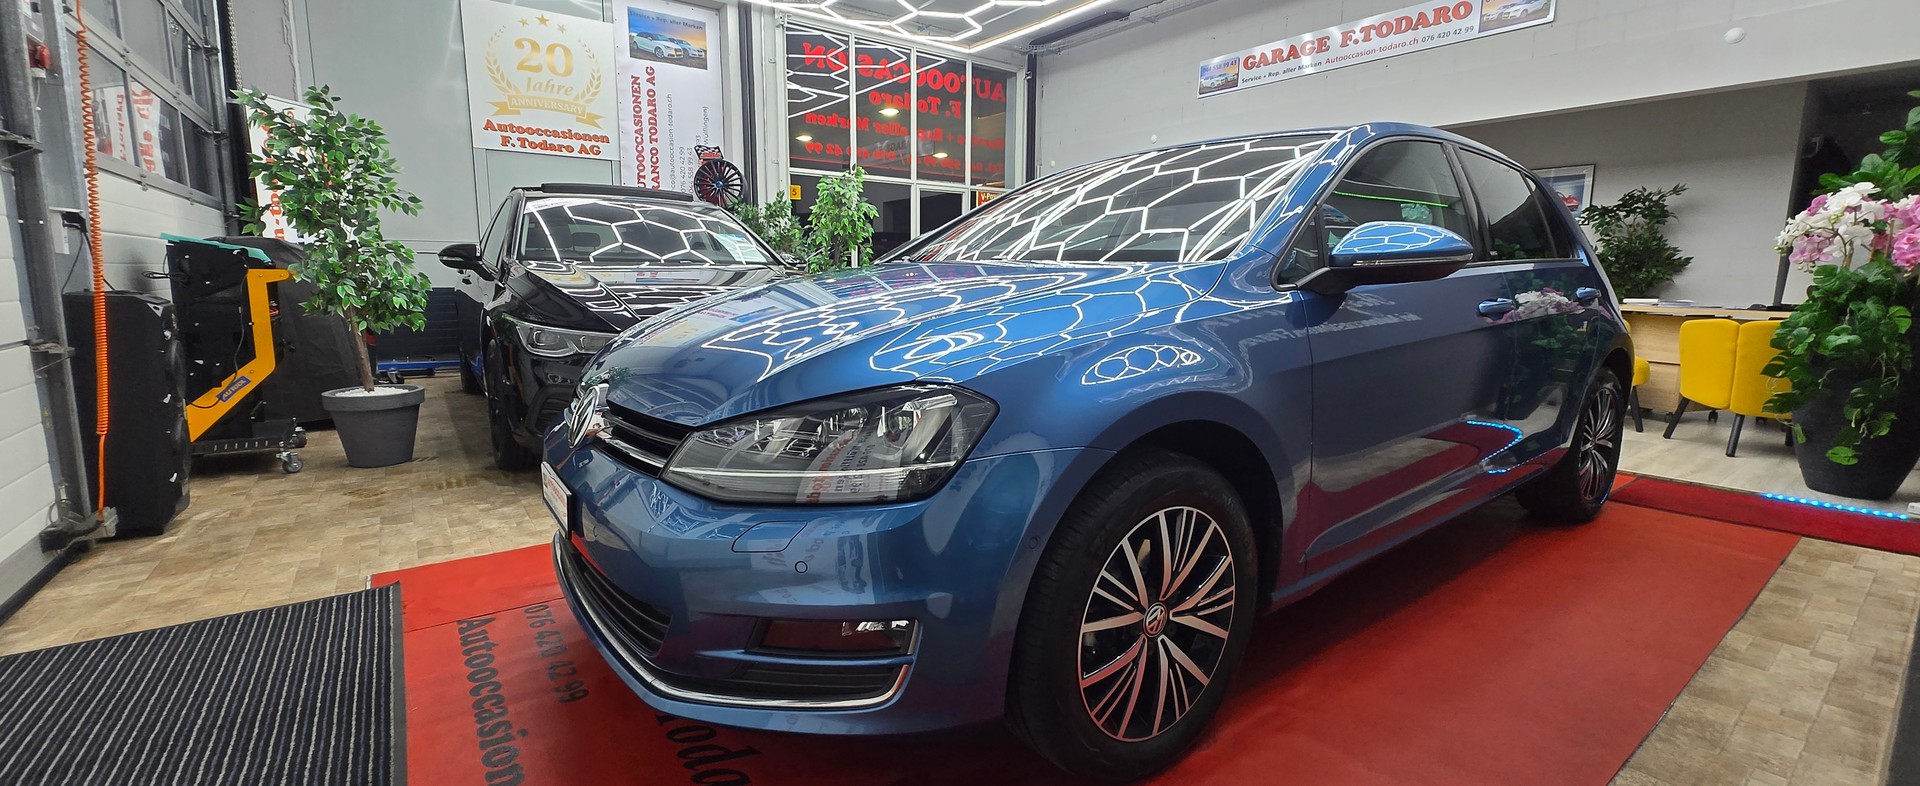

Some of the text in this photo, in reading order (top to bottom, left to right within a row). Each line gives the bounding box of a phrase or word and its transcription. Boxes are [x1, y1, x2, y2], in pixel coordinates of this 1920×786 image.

[682, 22, 703, 31] Marken
[1242, 1, 1474, 71] GARAGE F.TODARO
[1421, 25, 1474, 43] 076 420 42 99
[514, 37, 574, 77] 20
[1241, 75, 1262, 84] Service
[1282, 66, 1297, 75] aller
[1297, 61, 1322, 72] Marken
[1324, 38, 1419, 65] Autooccasion-todaro.ch
[526, 77, 574, 97] Jahre
[510, 97, 584, 115] ANNIVERSARY
[483, 119, 611, 144] Autooccasionen
[631, 75, 646, 189] UTOOCCASIONEN
[645, 65, 660, 190] ANCO TODARO AG
[500, 135, 602, 156] F. Todaro AG
[666, 93, 676, 191] co@autooccasion-todaro.ch
[679, 146, 685, 156] 99
[679, 156, 685, 165] 42
[792, 188, 798, 196] 5
[222, 379, 247, 401] AUTOOL
[524, 604, 590, 704] 076 420 42 99
